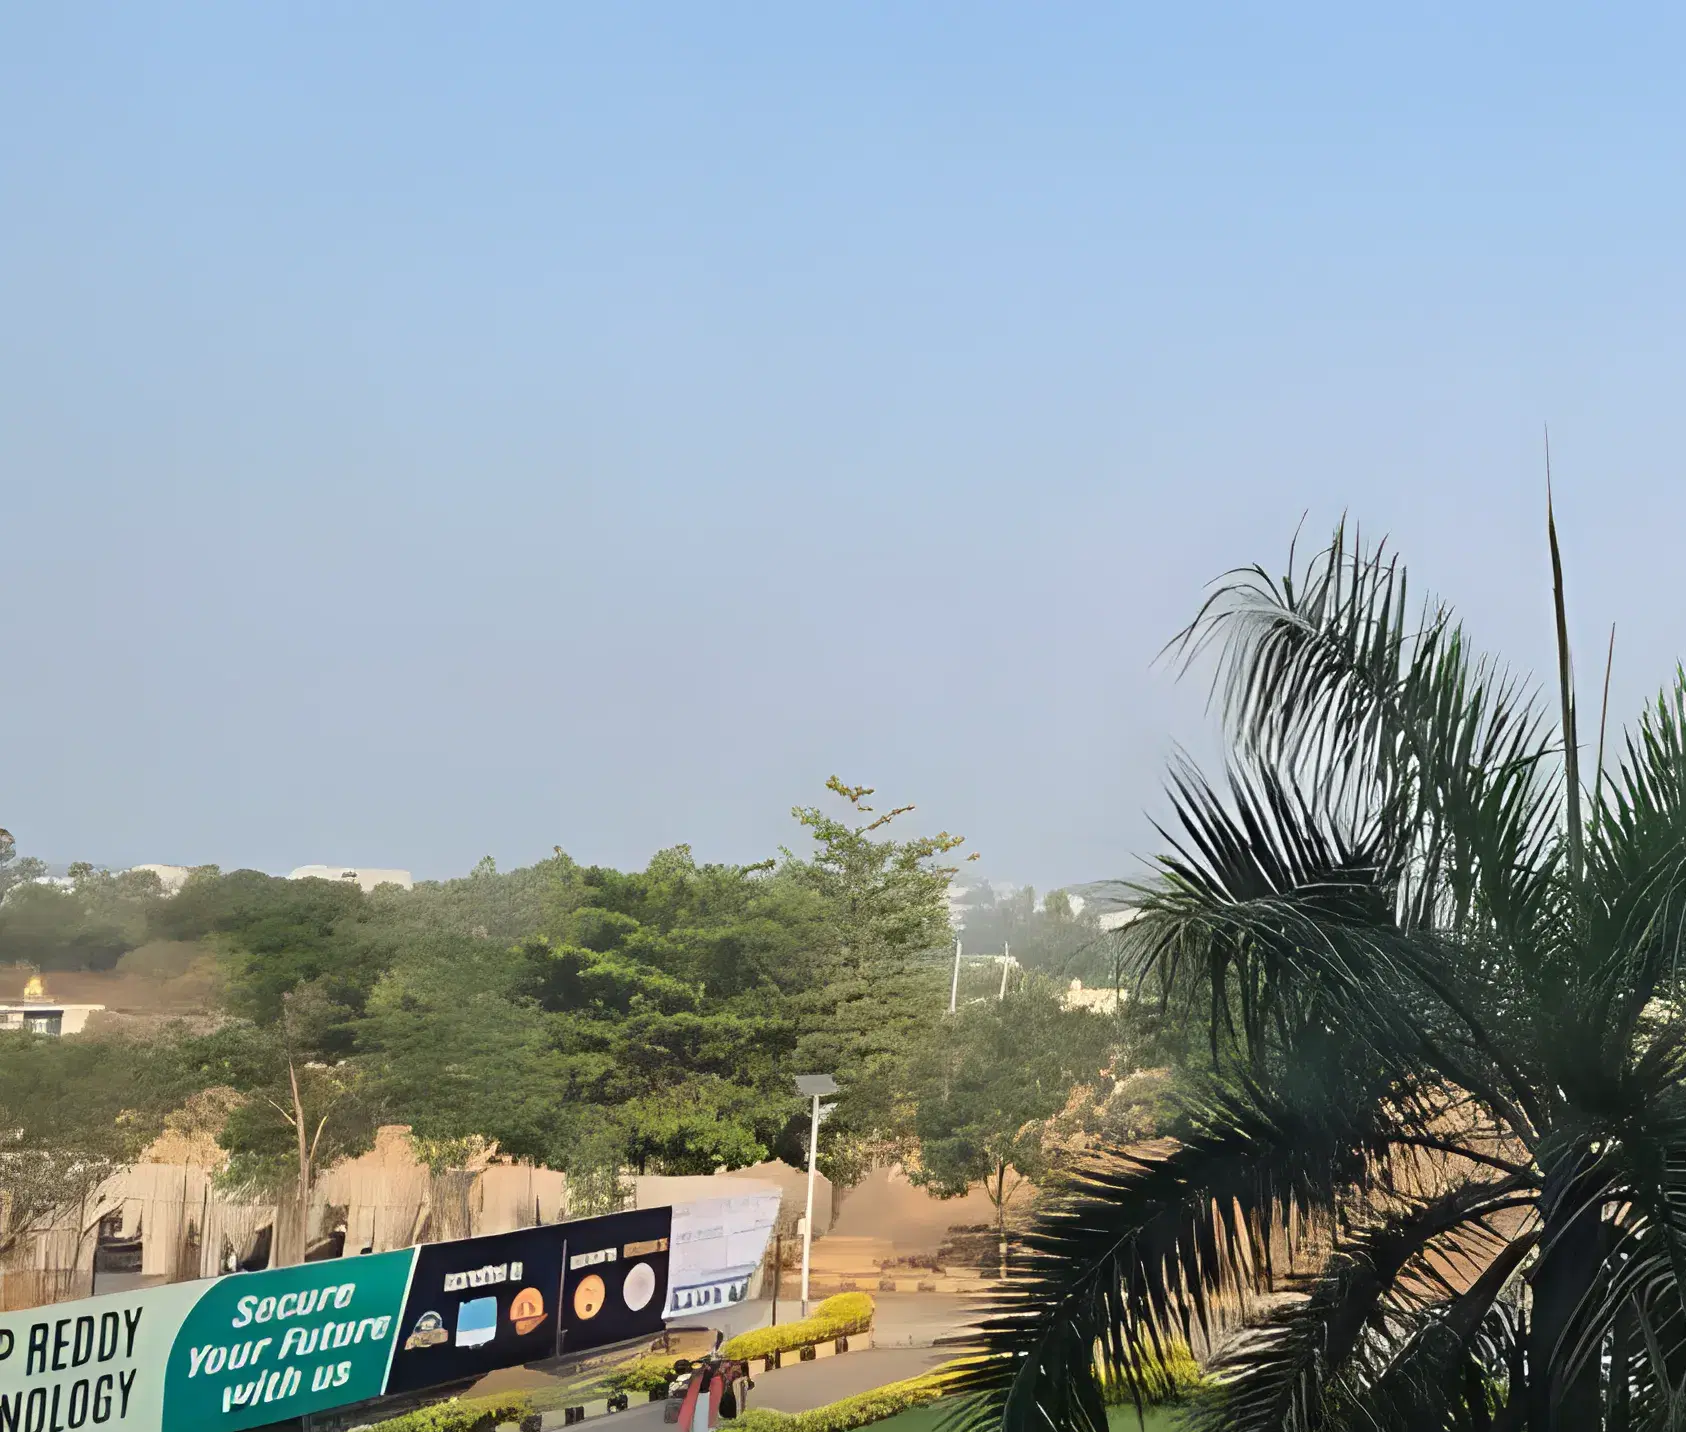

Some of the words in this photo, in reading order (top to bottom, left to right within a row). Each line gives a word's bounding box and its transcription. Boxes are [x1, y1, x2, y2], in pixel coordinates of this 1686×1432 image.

[26, 1306, 143, 1377] REDDY
[188, 1337, 273, 1379] Your
[222, 1366, 302, 1413] with
[312, 1360, 352, 1393] us
